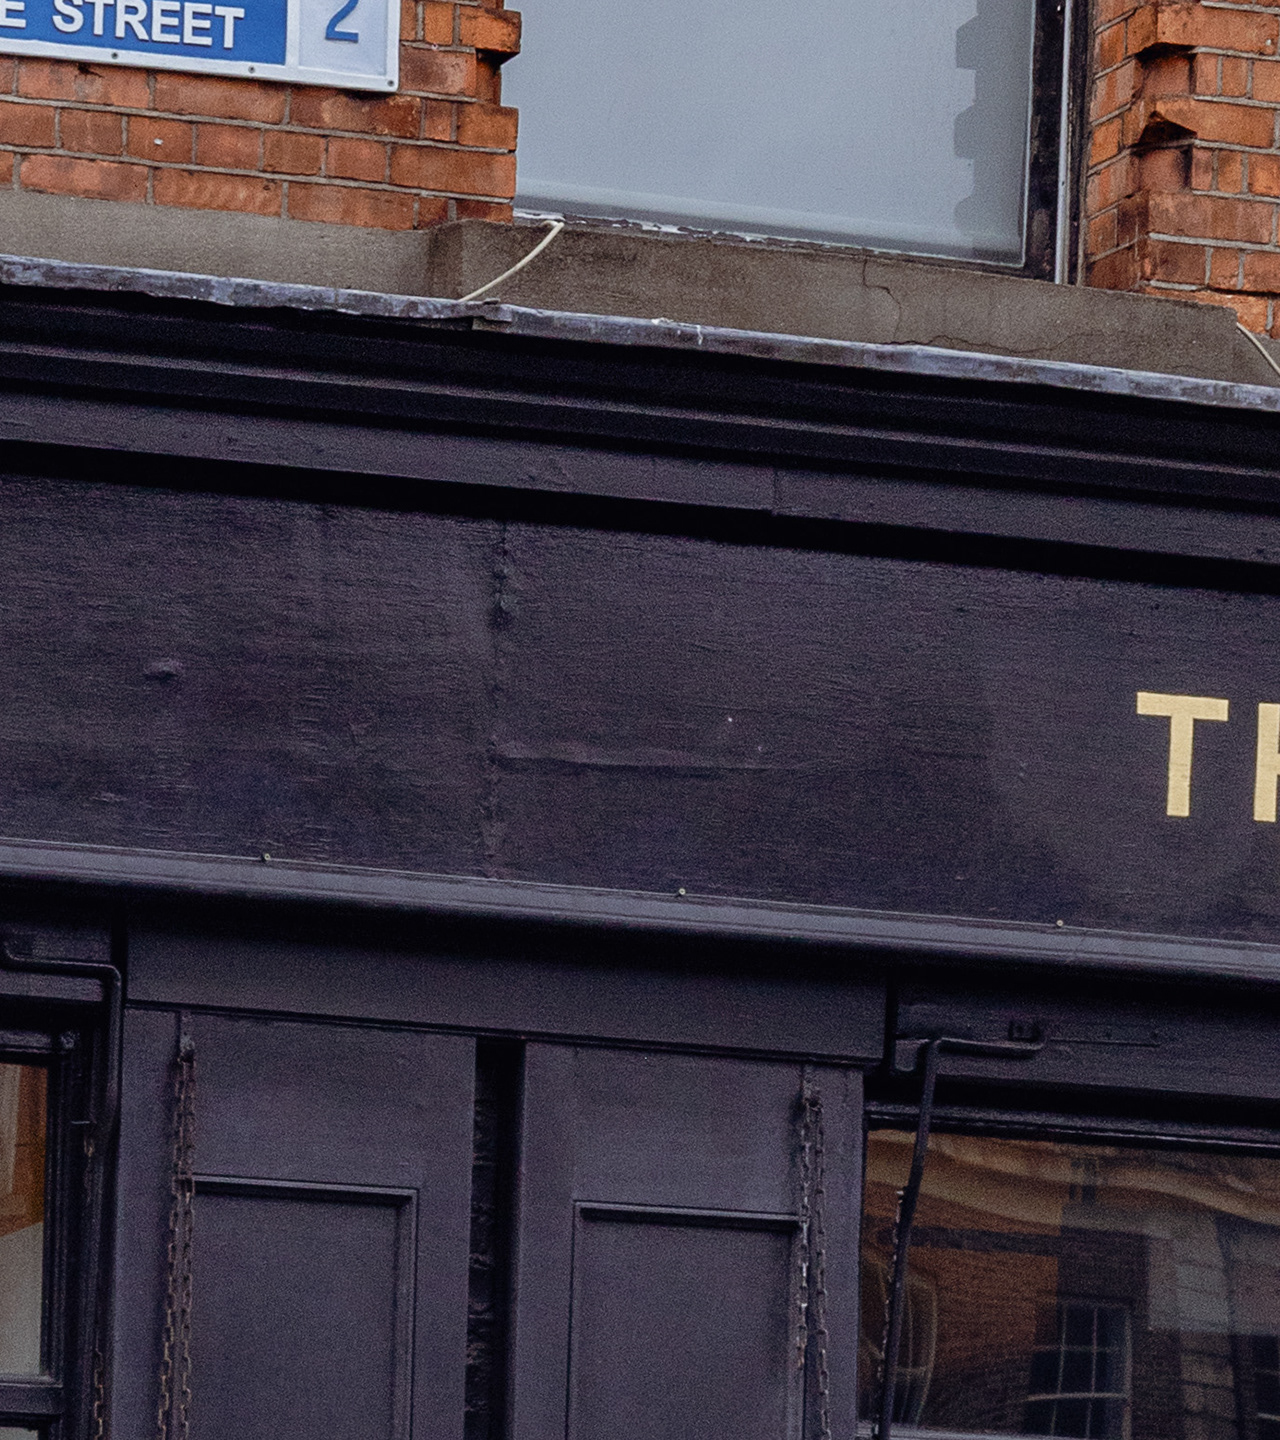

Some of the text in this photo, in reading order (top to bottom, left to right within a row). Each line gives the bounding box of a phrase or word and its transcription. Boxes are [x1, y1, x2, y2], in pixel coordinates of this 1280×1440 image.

[52, 0, 246, 49] STREET
[325, 0, 359, 43] 2
[1137, 692, 1280, 823] T
